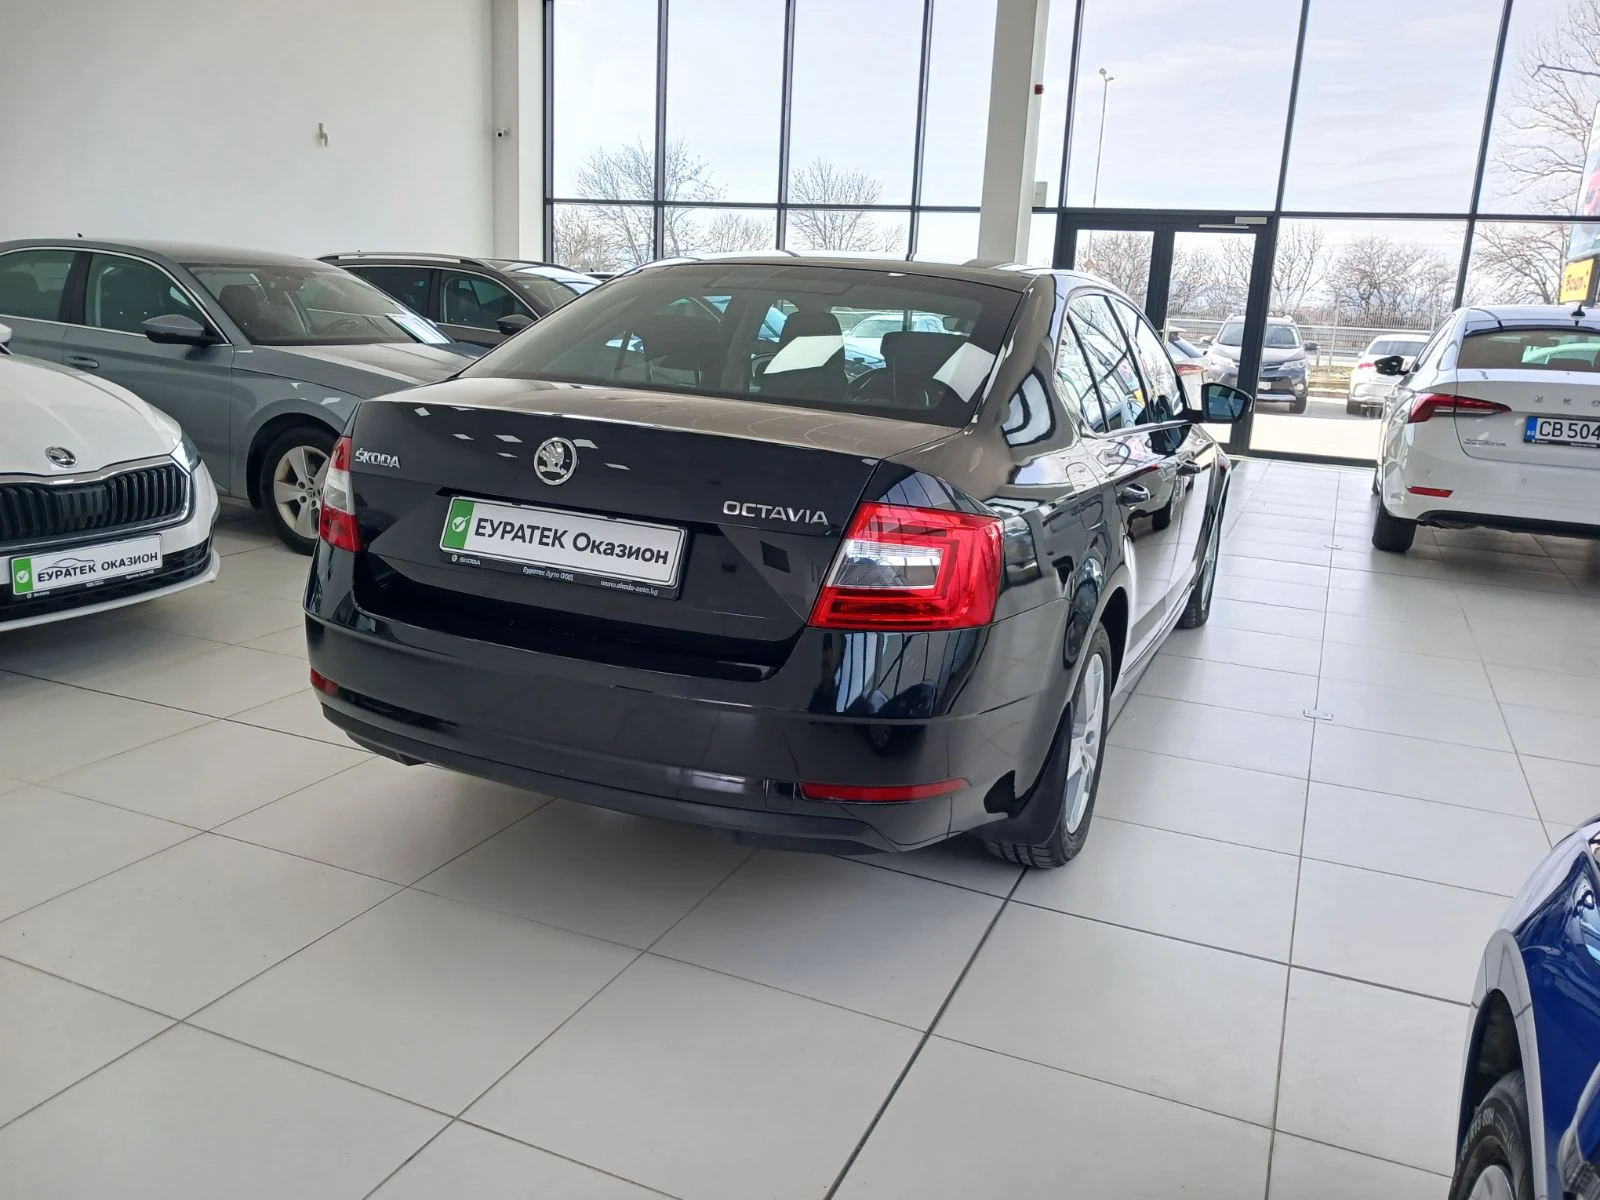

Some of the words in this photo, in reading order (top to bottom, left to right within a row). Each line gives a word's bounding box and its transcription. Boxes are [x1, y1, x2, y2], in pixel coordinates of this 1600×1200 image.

[1540, 421, 1563, 437] CB
[1567, 423, 1600, 440] 504
[355, 447, 400, 469] ŠKODA
[723, 500, 828, 525] OCTAVIA
[474, 517, 568, 549] ЕУРАТЕК
[572, 532, 669, 565] Оказион
[37, 564, 97, 582] ЕУРАТЕК
[101, 552, 158, 570] ОКАЗИОН
